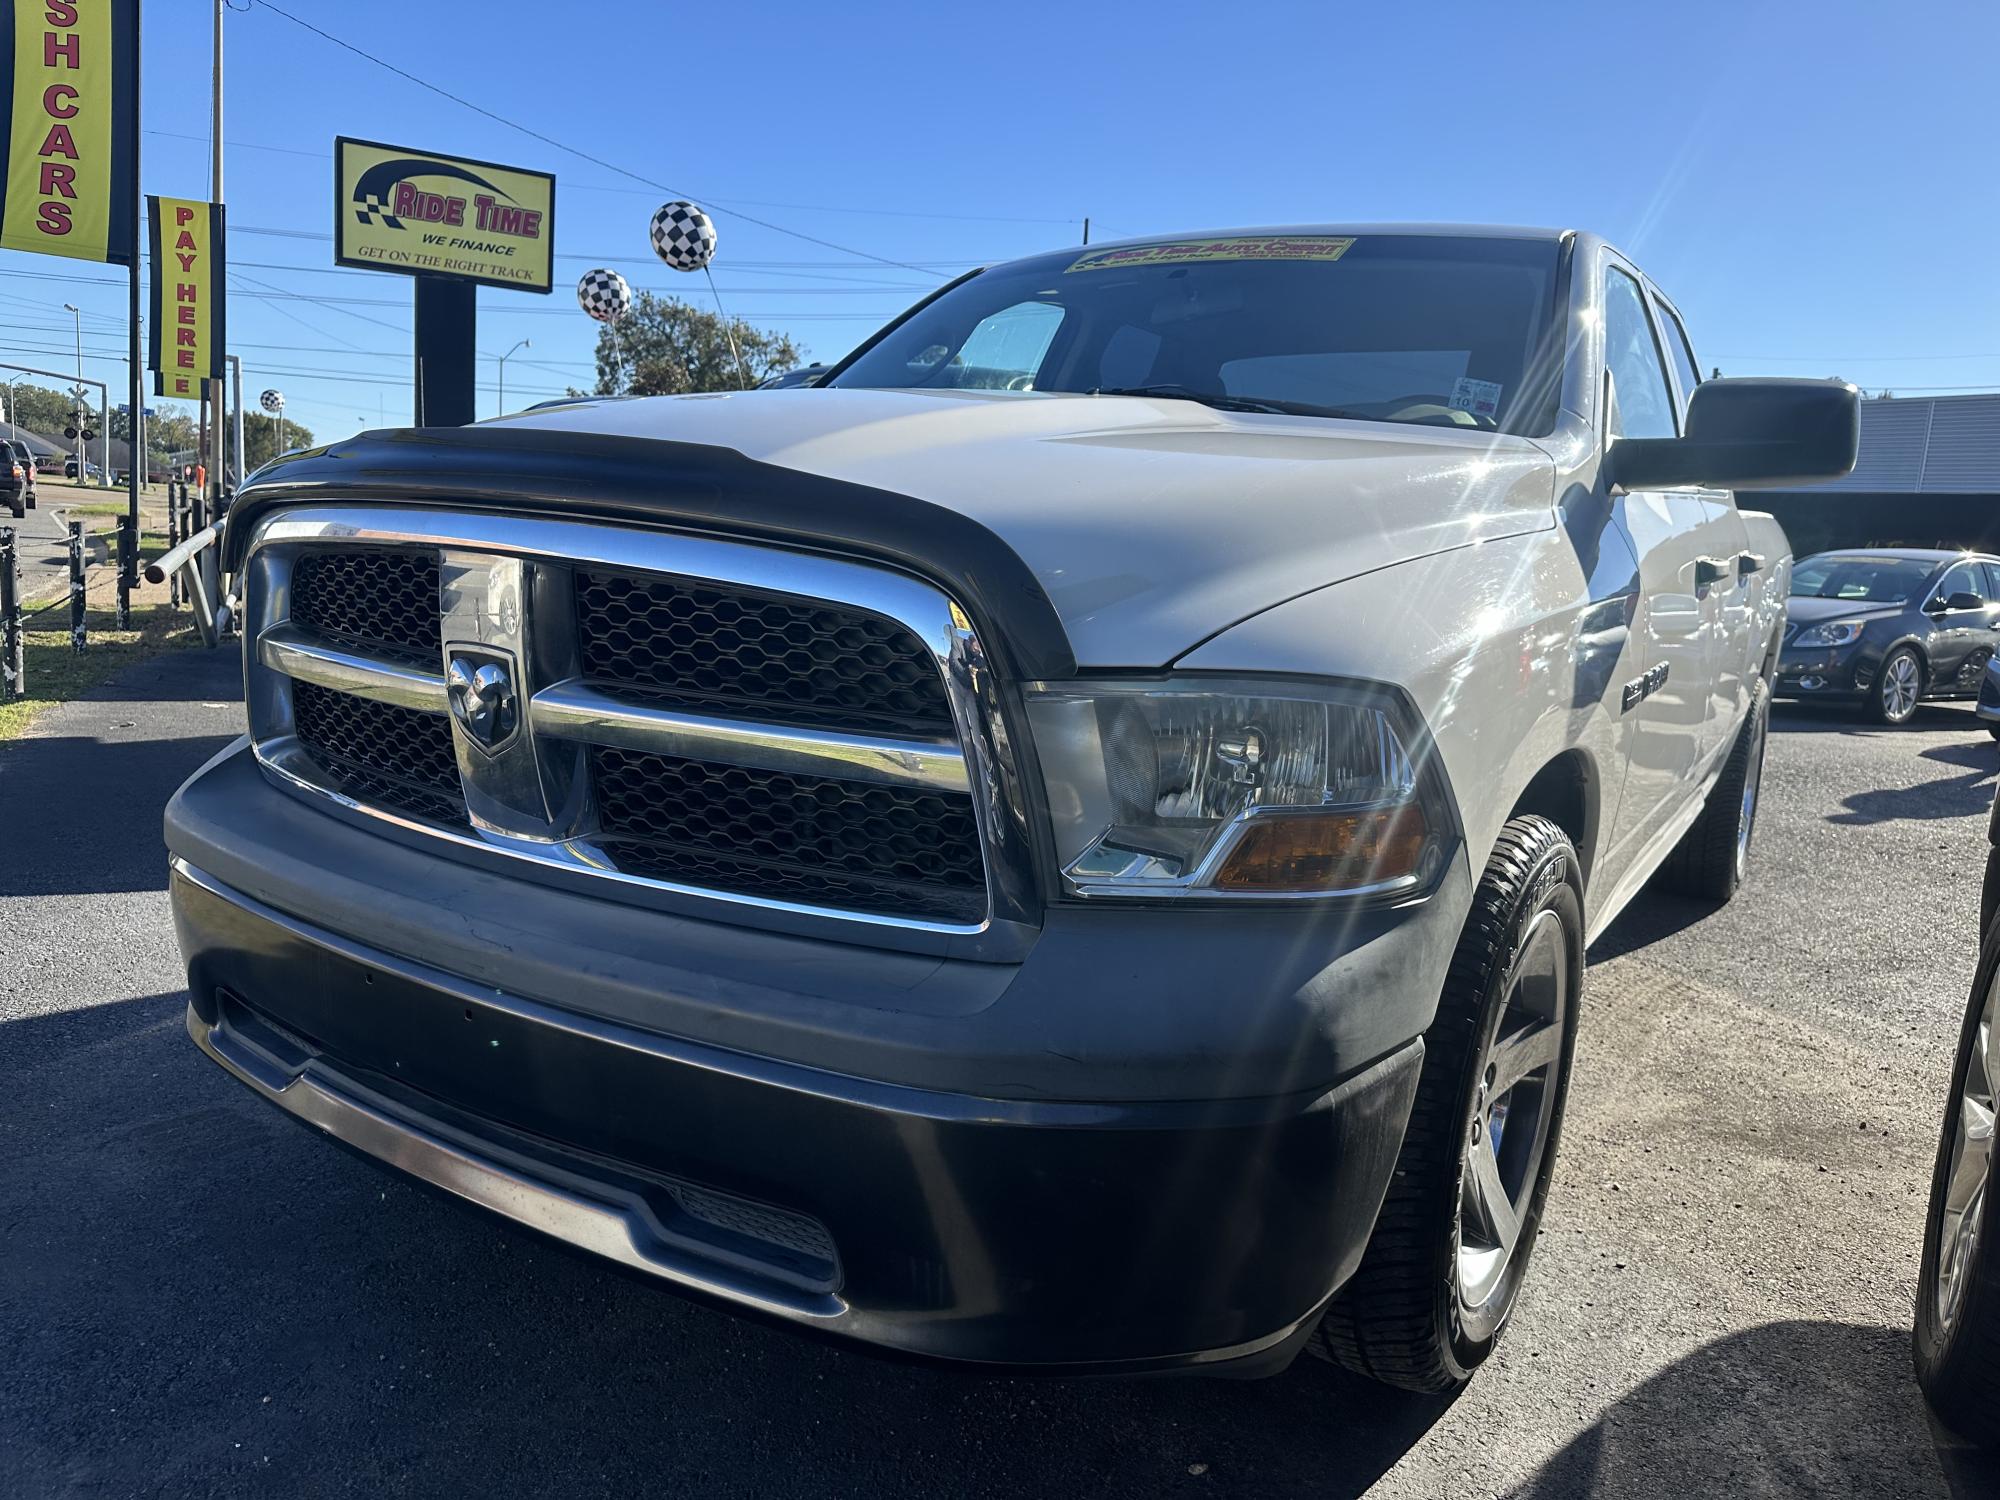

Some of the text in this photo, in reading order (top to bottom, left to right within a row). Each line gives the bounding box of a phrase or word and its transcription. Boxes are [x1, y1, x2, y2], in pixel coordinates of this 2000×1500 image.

[37, 84, 79, 235] CARS
[394, 181, 542, 239] RIDE TIME
[358, 246, 534, 281] GET ON THE RIGHT TRACK
[422, 234, 516, 257] WE FINANCE
[176, 207, 197, 369] PAY HERE
